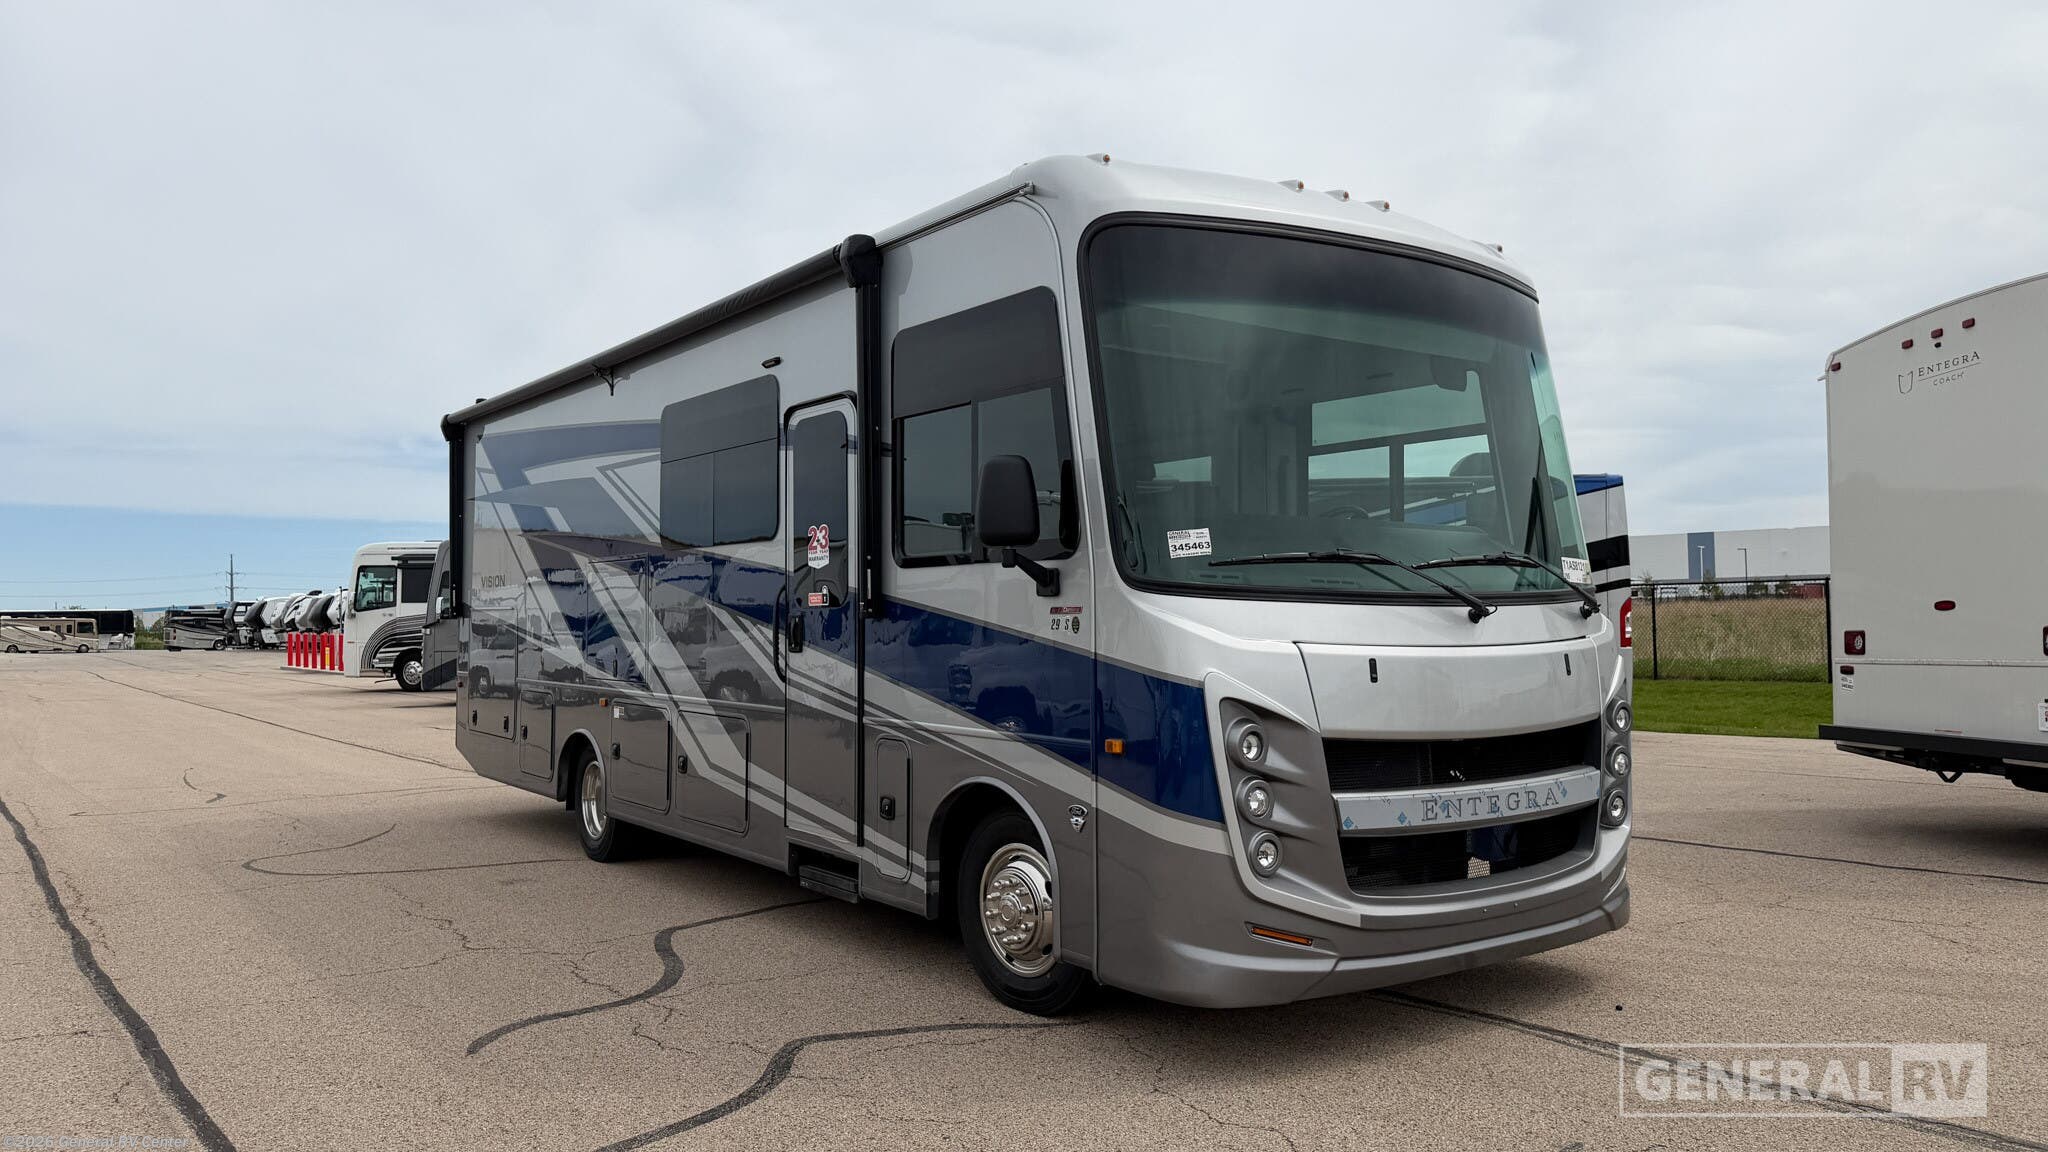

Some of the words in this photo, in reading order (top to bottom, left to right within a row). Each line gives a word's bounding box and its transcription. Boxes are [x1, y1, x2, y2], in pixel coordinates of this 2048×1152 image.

[1918, 350, 1980, 377] ENTEGRA
[1933, 371, 1964, 386] COACH
[1170, 541, 1211, 552] 345463
[481, 574, 506, 588] VISION
[1051, 618, 1060, 630] 29
[1421, 786, 1560, 822] ENTEGRA
